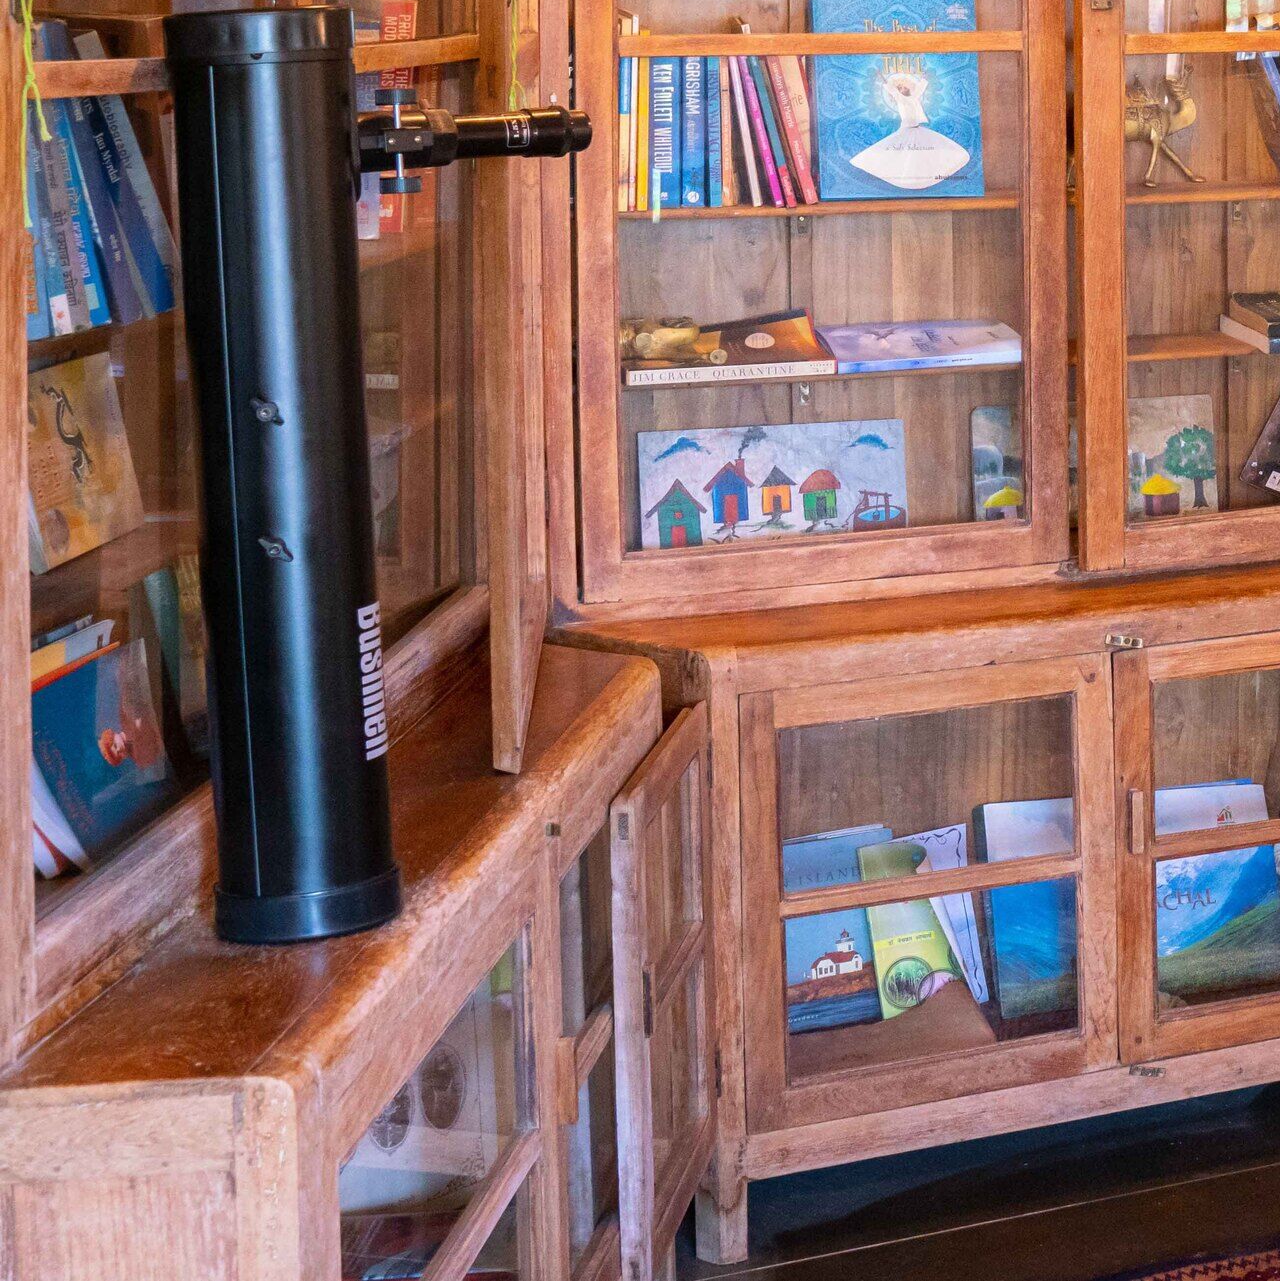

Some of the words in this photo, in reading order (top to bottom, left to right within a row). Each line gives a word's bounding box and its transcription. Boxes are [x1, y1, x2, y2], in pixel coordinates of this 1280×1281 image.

[384, 16, 398, 41] MOD
[399, 14, 412, 40] PRIC
[863, 19, 883, 33] The
[891, 19, 915, 33] Best
[925, 19, 938, 33] of
[382, 67, 395, 88] ARS
[653, 64, 674, 84] KEN
[770, 61, 784, 92] Tuesdays
[685, 62, 701, 115] GRISHAM
[779, 92, 788, 106] with
[653, 86, 674, 123] FOLLETT
[783, 106, 796, 129] Morrie
[653, 127, 673, 174] WHITEOUT
[907, 143, 935, 151] Selection
[101, 150, 119, 184] Myrdal
[631, 372, 655, 385] JIM
[657, 370, 701, 382] CRACE
[712, 365, 797, 379] QUARANTINE
[799, 867, 860, 887] ISLAND
